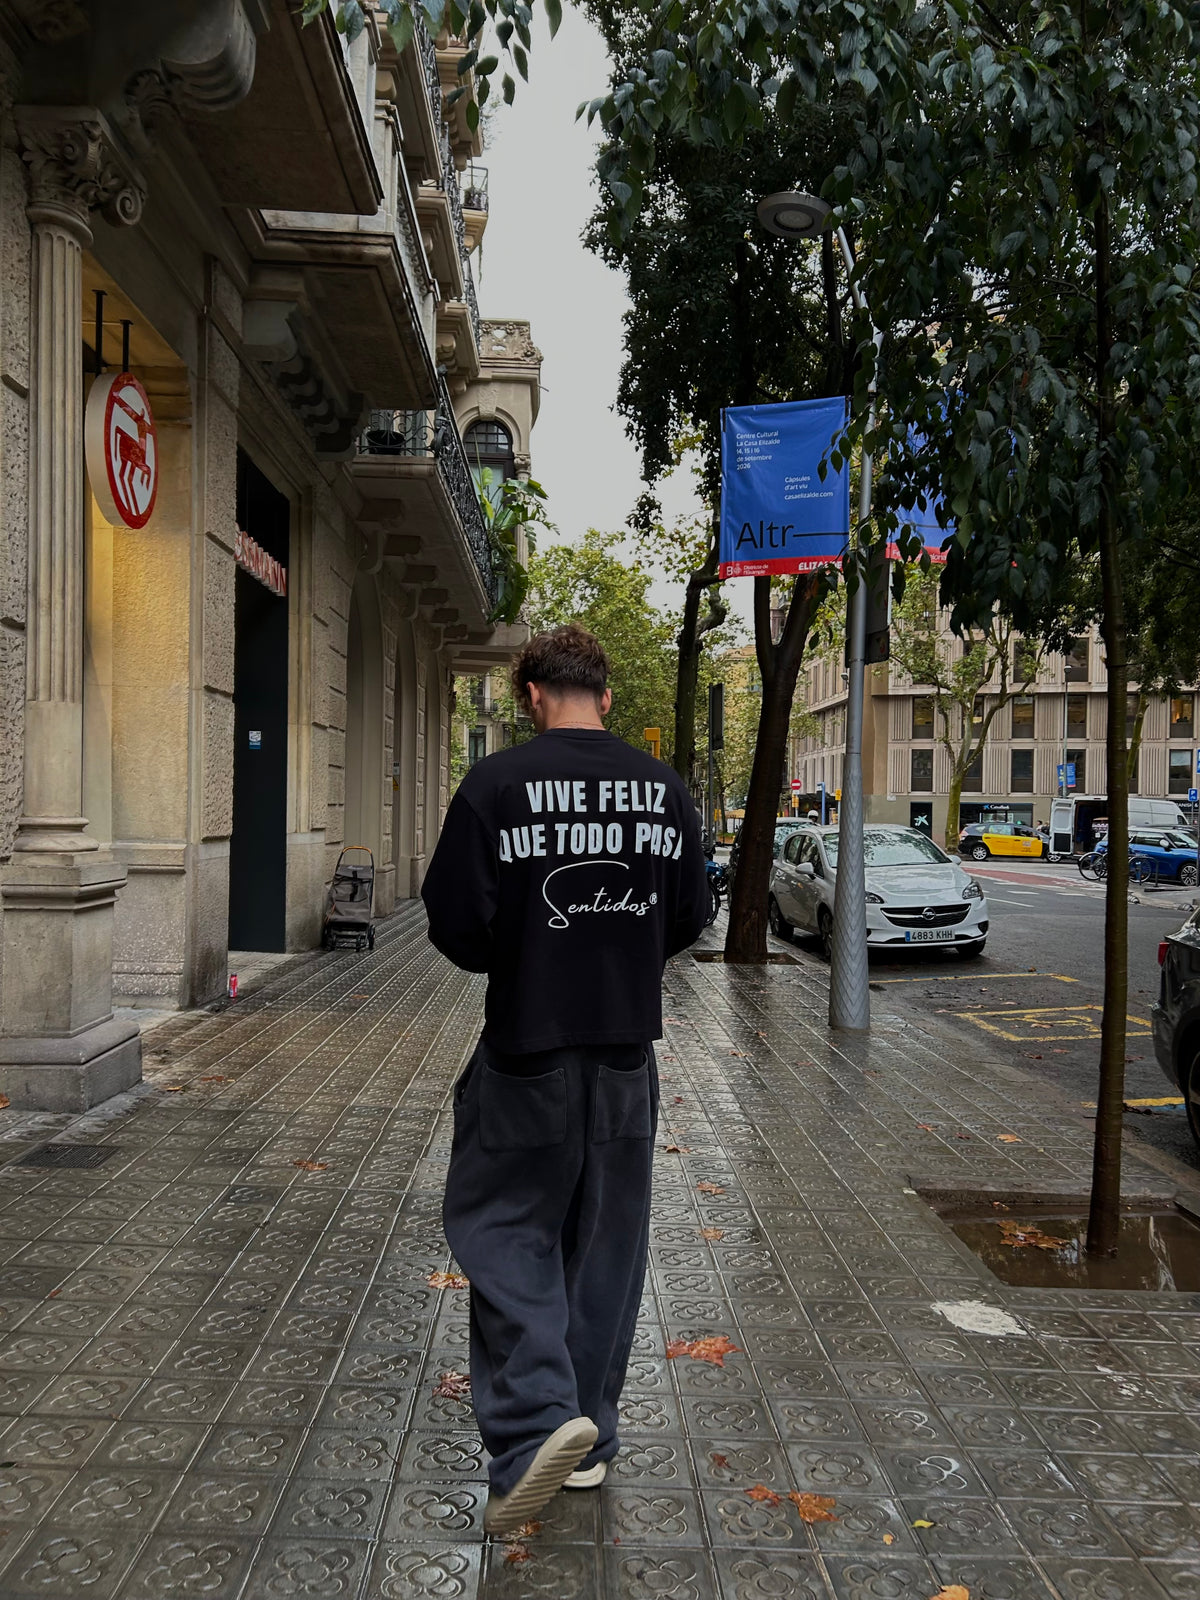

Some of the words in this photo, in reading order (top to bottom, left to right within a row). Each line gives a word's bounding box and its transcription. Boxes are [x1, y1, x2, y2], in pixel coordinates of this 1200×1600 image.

[756, 430, 779, 439] Cultural
[758, 438, 780, 446] Elizalde
[784, 491, 834, 500] casaelizalde.com
[525, 780, 587, 813] VIVE
[599, 780, 666, 814] FELIZ
[499, 823, 547, 863] QUE
[554, 822, 623, 855] TODO
[911, 931, 934, 940] 4883
[936, 930, 953, 939] KHH
